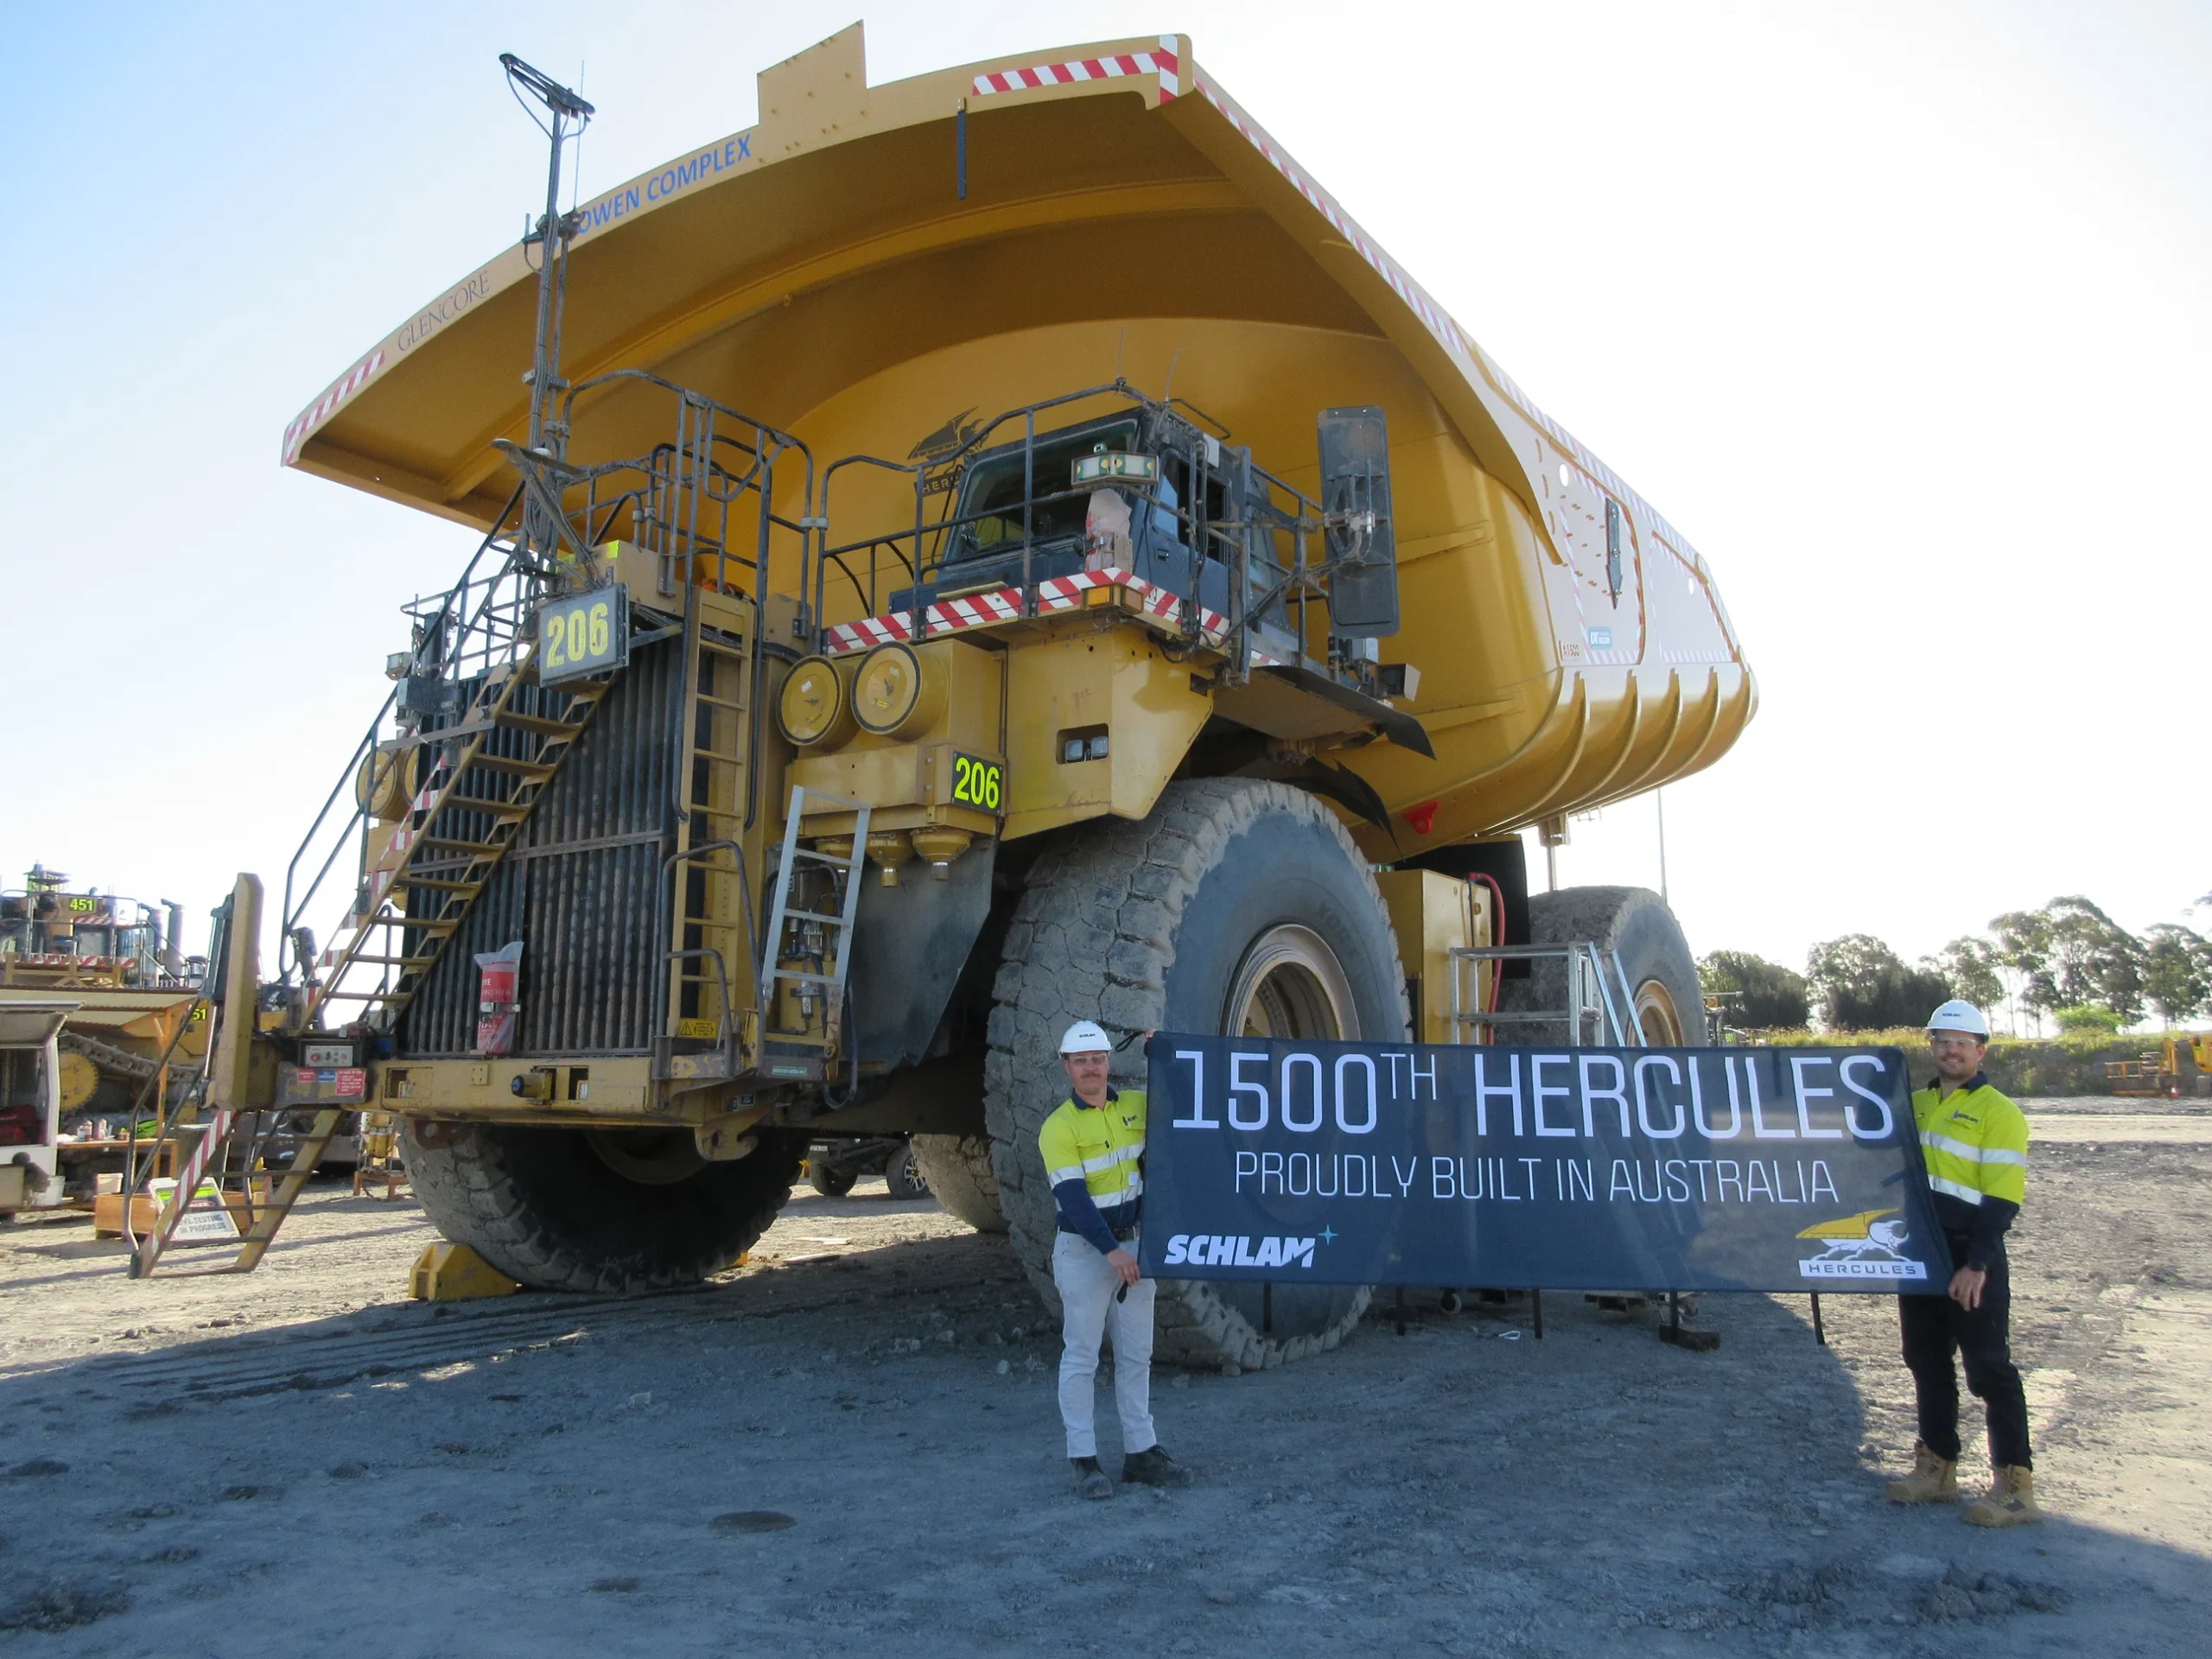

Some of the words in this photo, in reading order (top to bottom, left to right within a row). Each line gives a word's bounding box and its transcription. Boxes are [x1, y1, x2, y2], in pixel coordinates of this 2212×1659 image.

[564, 186, 640, 240] OWEN
[647, 133, 752, 202] COMPLEX
[397, 270, 490, 352] GLENCORE
[546, 602, 609, 669] 206
[954, 757, 1001, 810] 206
[69, 898, 94, 912] 451
[192, 1008, 207, 1020] 51
[1474, 1053, 1893, 1140] HERCULES
[1235, 1151, 1417, 1198] PROUDLY
[1432, 1156, 1541, 1201] BUILT
[1556, 1158, 1594, 1201] IN
[1609, 1159, 1839, 1204] AUSTRALIA
[1164, 1234, 1316, 1268] SCHLAM
[1808, 1263, 1916, 1275] HERCULES
